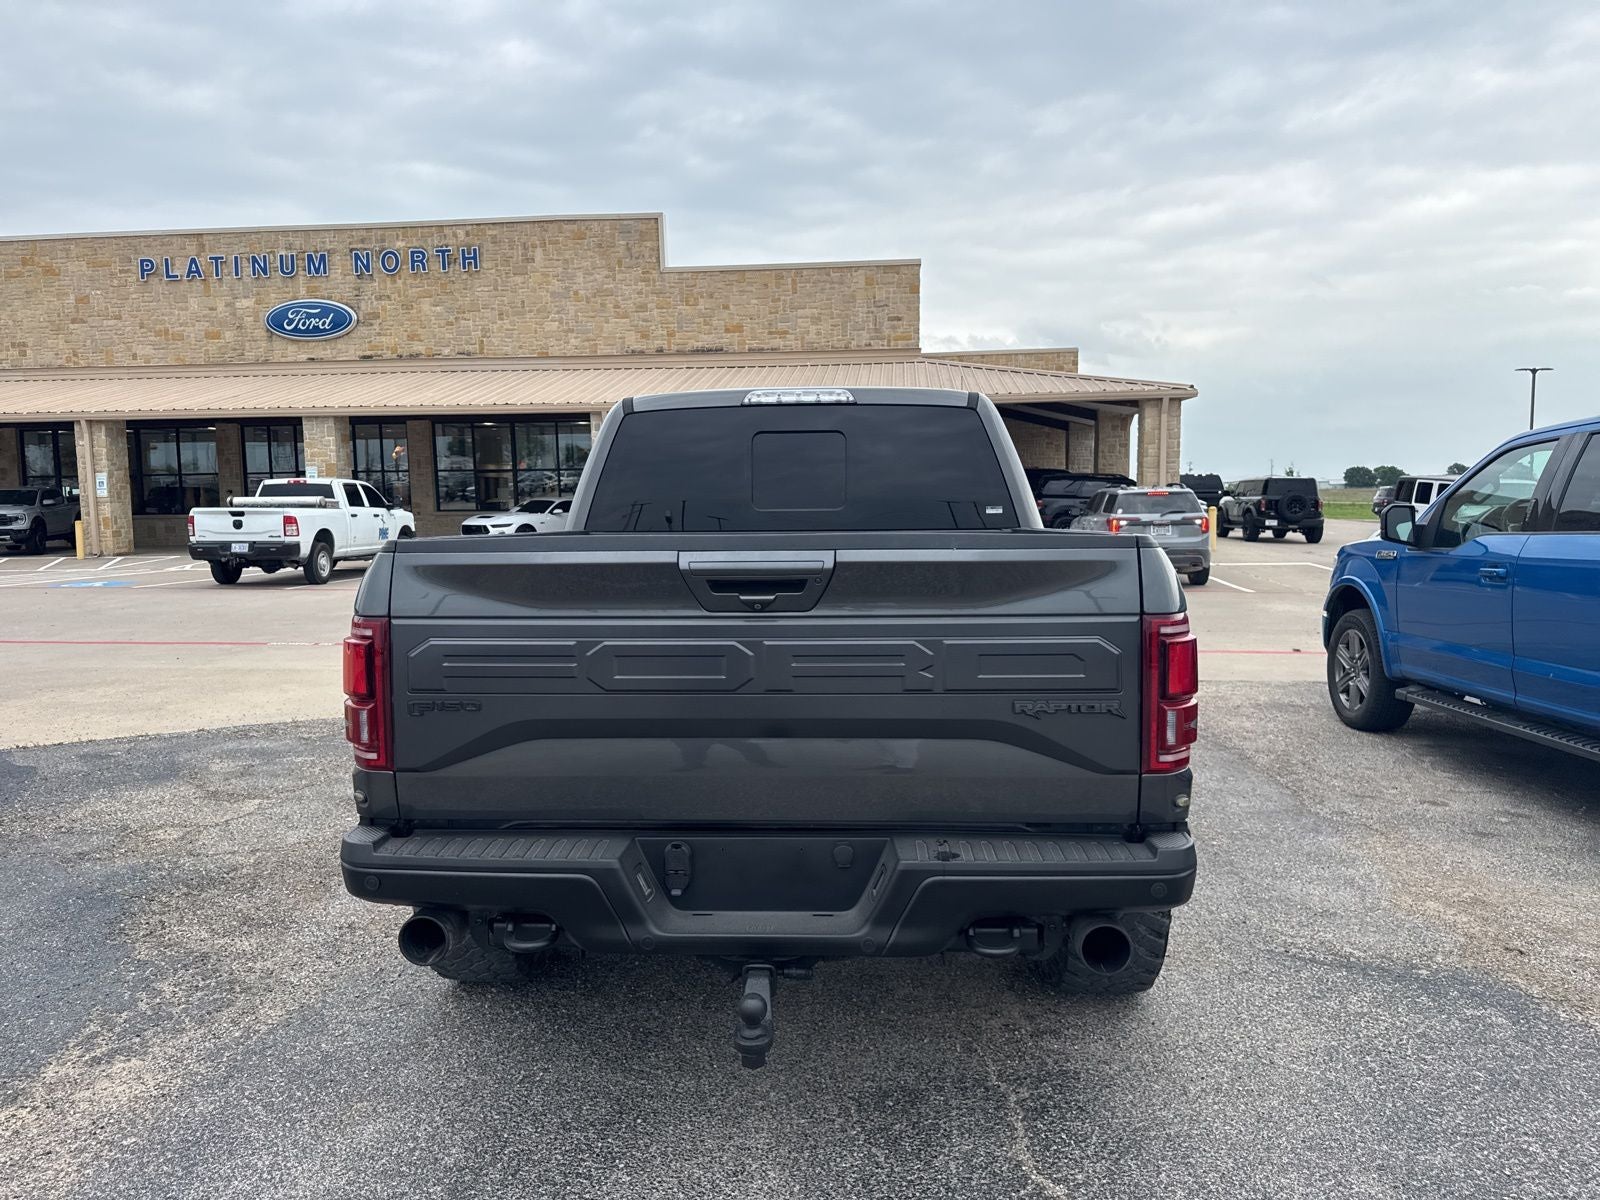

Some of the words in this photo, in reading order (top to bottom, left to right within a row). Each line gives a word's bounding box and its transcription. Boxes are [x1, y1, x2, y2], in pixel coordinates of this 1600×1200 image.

[138, 252, 328, 281] PLATINUM
[353, 246, 480, 275] NORTH
[283, 308, 334, 331] Ford
[1012, 700, 1127, 720] RAPTOR
